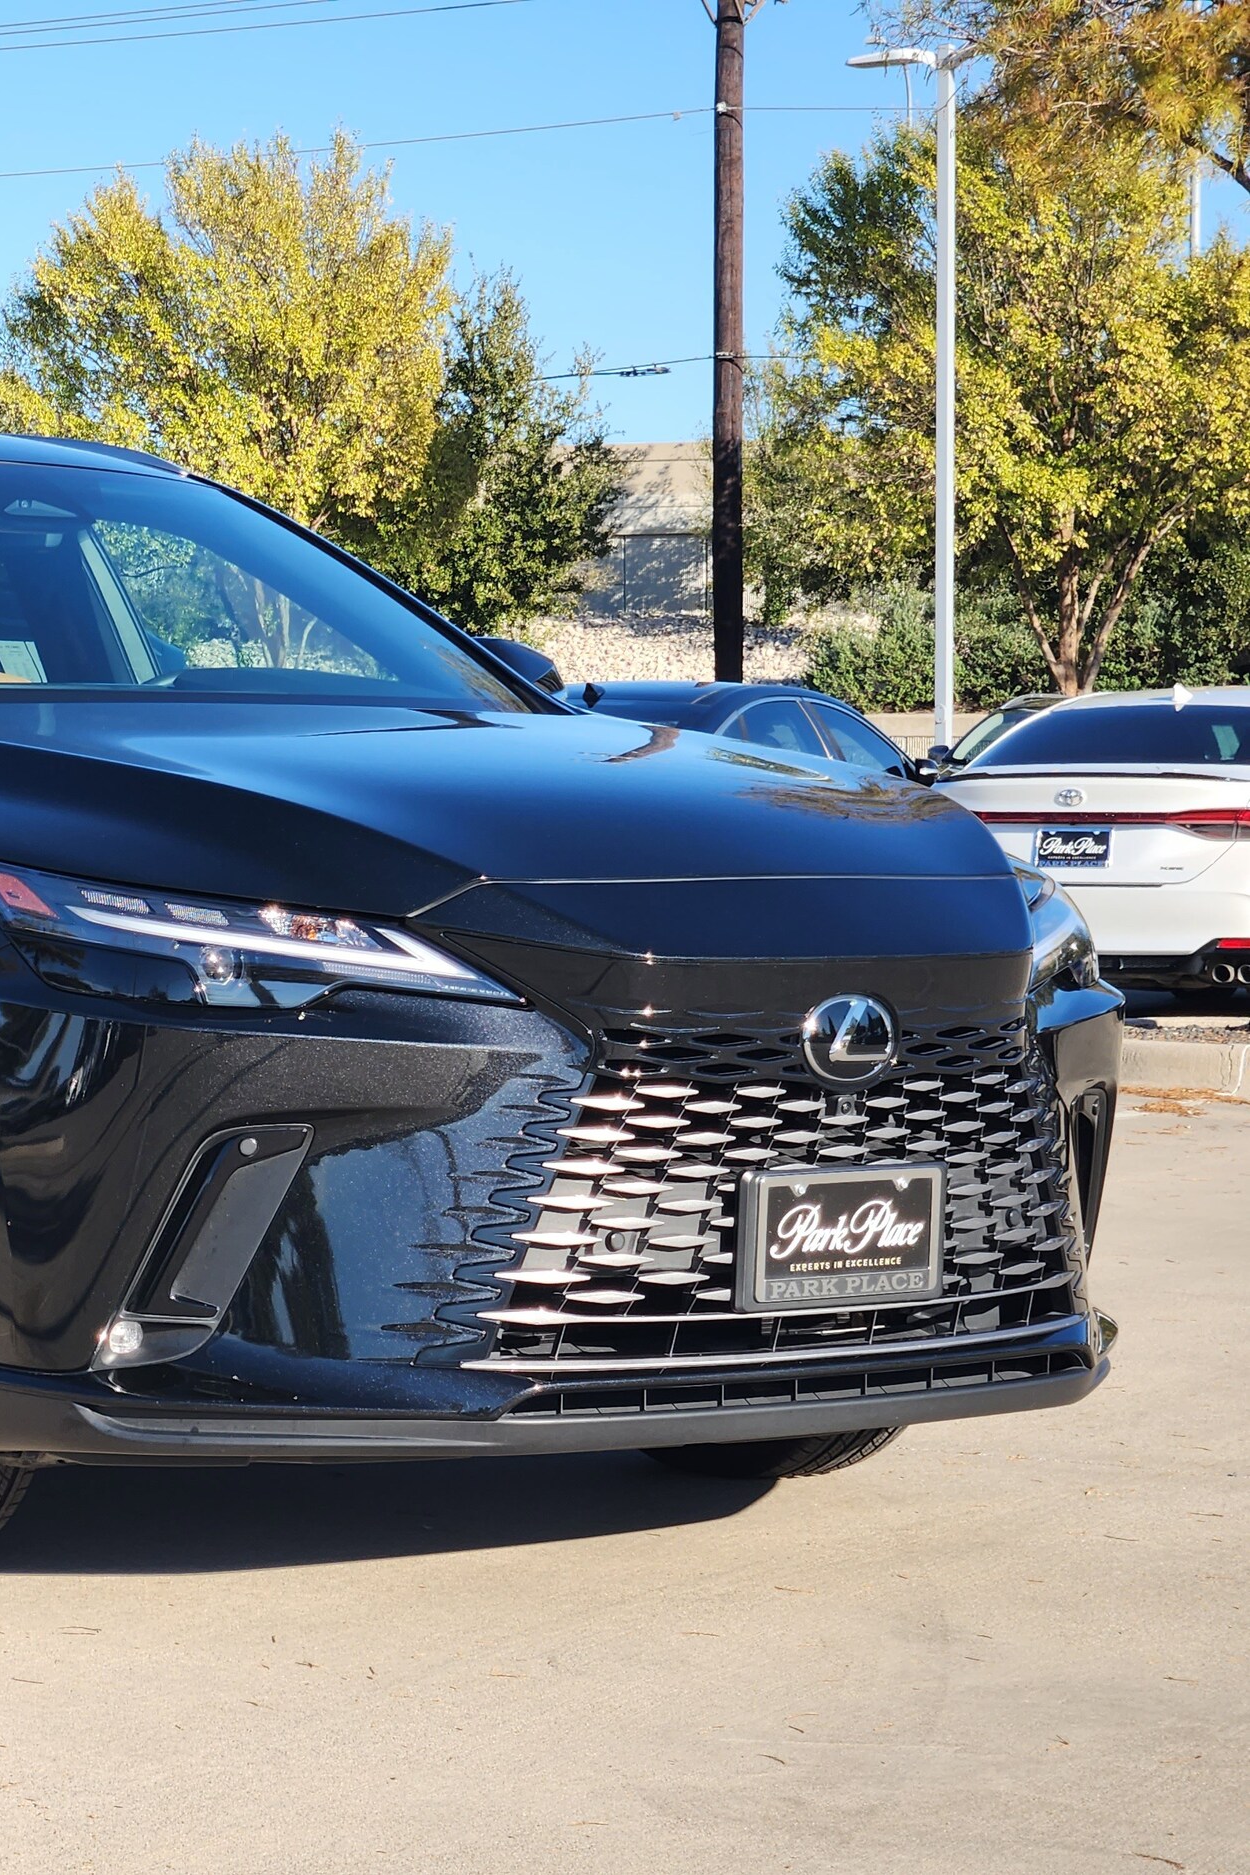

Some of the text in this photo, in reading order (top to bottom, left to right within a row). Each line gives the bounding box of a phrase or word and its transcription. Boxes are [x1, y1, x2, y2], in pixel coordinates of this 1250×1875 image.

[1039, 836, 1107, 855] Park Place
[769, 1200, 925, 1259] Park Place
[789, 1256, 902, 1272] EXPERTS IN EXCELLENCE
[769, 1272, 924, 1299] PARK PLACE
